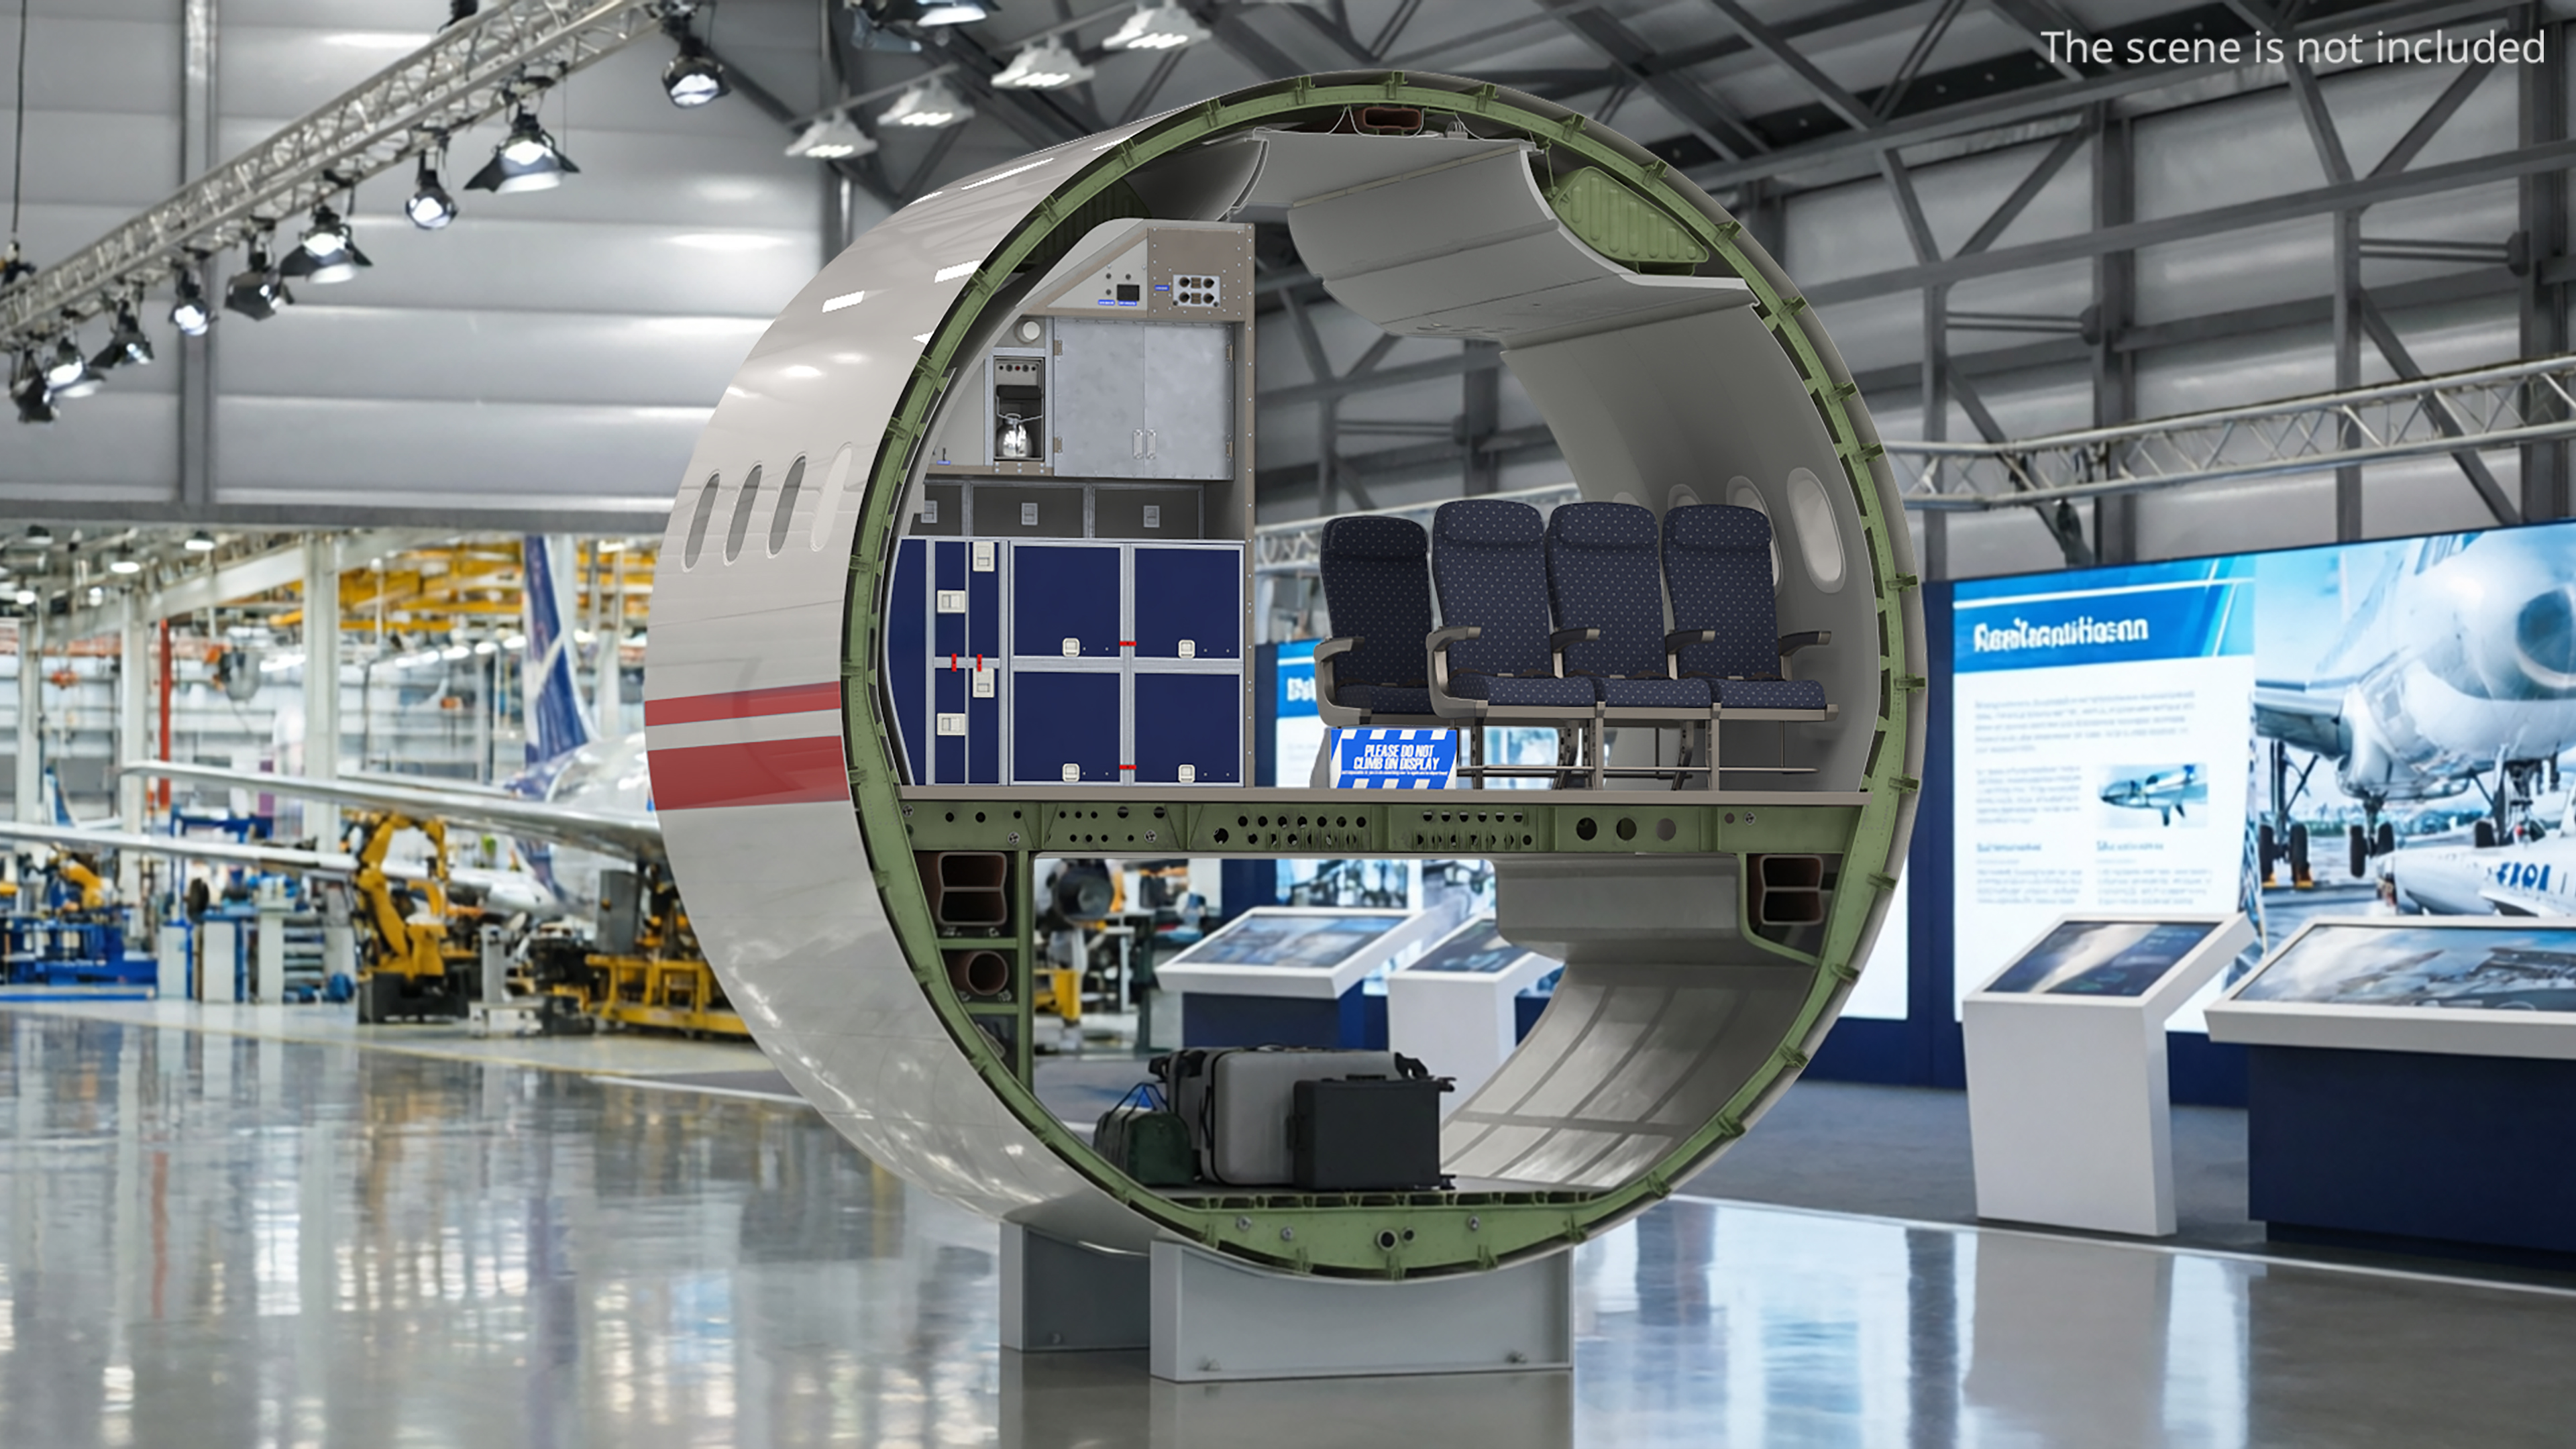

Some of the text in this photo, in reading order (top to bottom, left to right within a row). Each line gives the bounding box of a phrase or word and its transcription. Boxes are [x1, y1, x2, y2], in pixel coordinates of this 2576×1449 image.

[1364, 745, 1435, 757] PLEASE DO NOT
[1353, 756, 1440, 771] CLIMB ON DISPLAY
